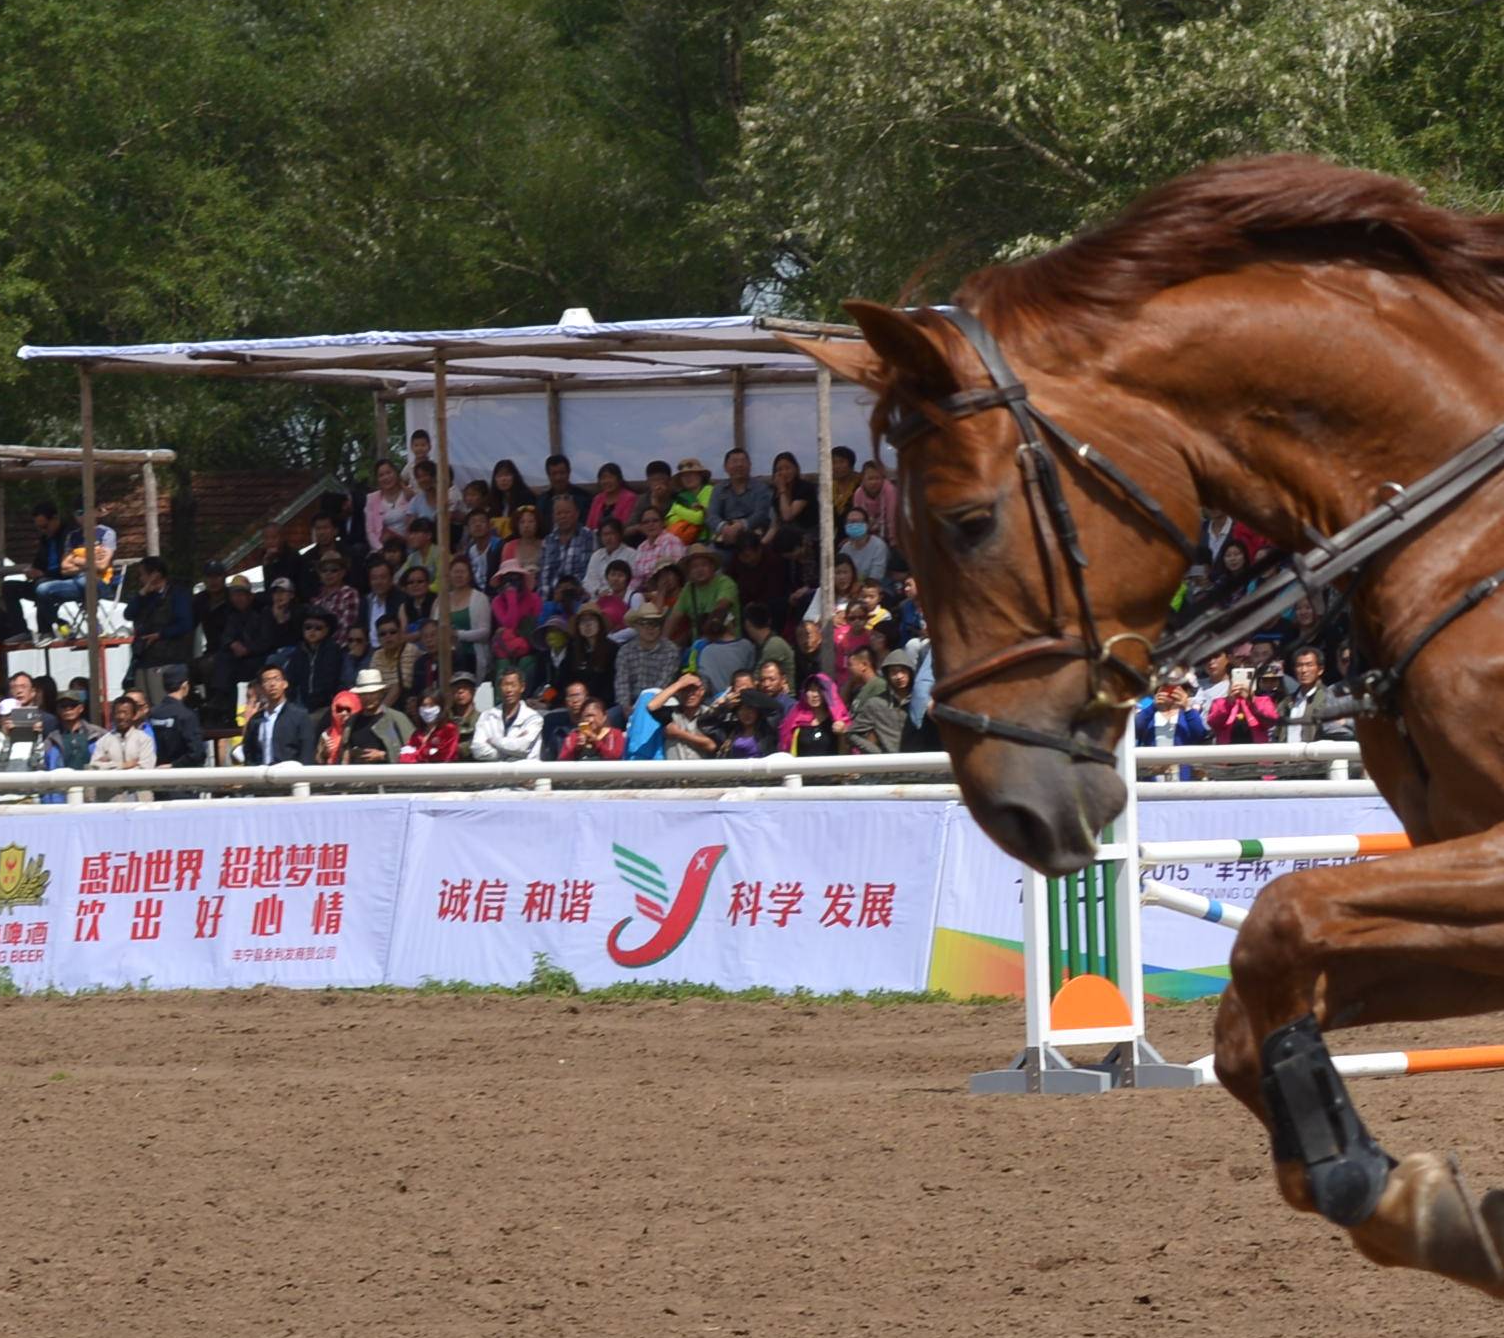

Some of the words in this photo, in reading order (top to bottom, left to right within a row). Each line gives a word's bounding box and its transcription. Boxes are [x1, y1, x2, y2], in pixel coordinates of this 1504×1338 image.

[78, 849, 204, 894] 感动世界
[218, 843, 349, 889] 超越梦想
[436, 878, 507, 923] 诚信
[521, 878, 594, 924] 和谐
[727, 880, 802, 928] 科学
[819, 882, 896, 929] 发展
[10, 949, 45, 963] BEER
